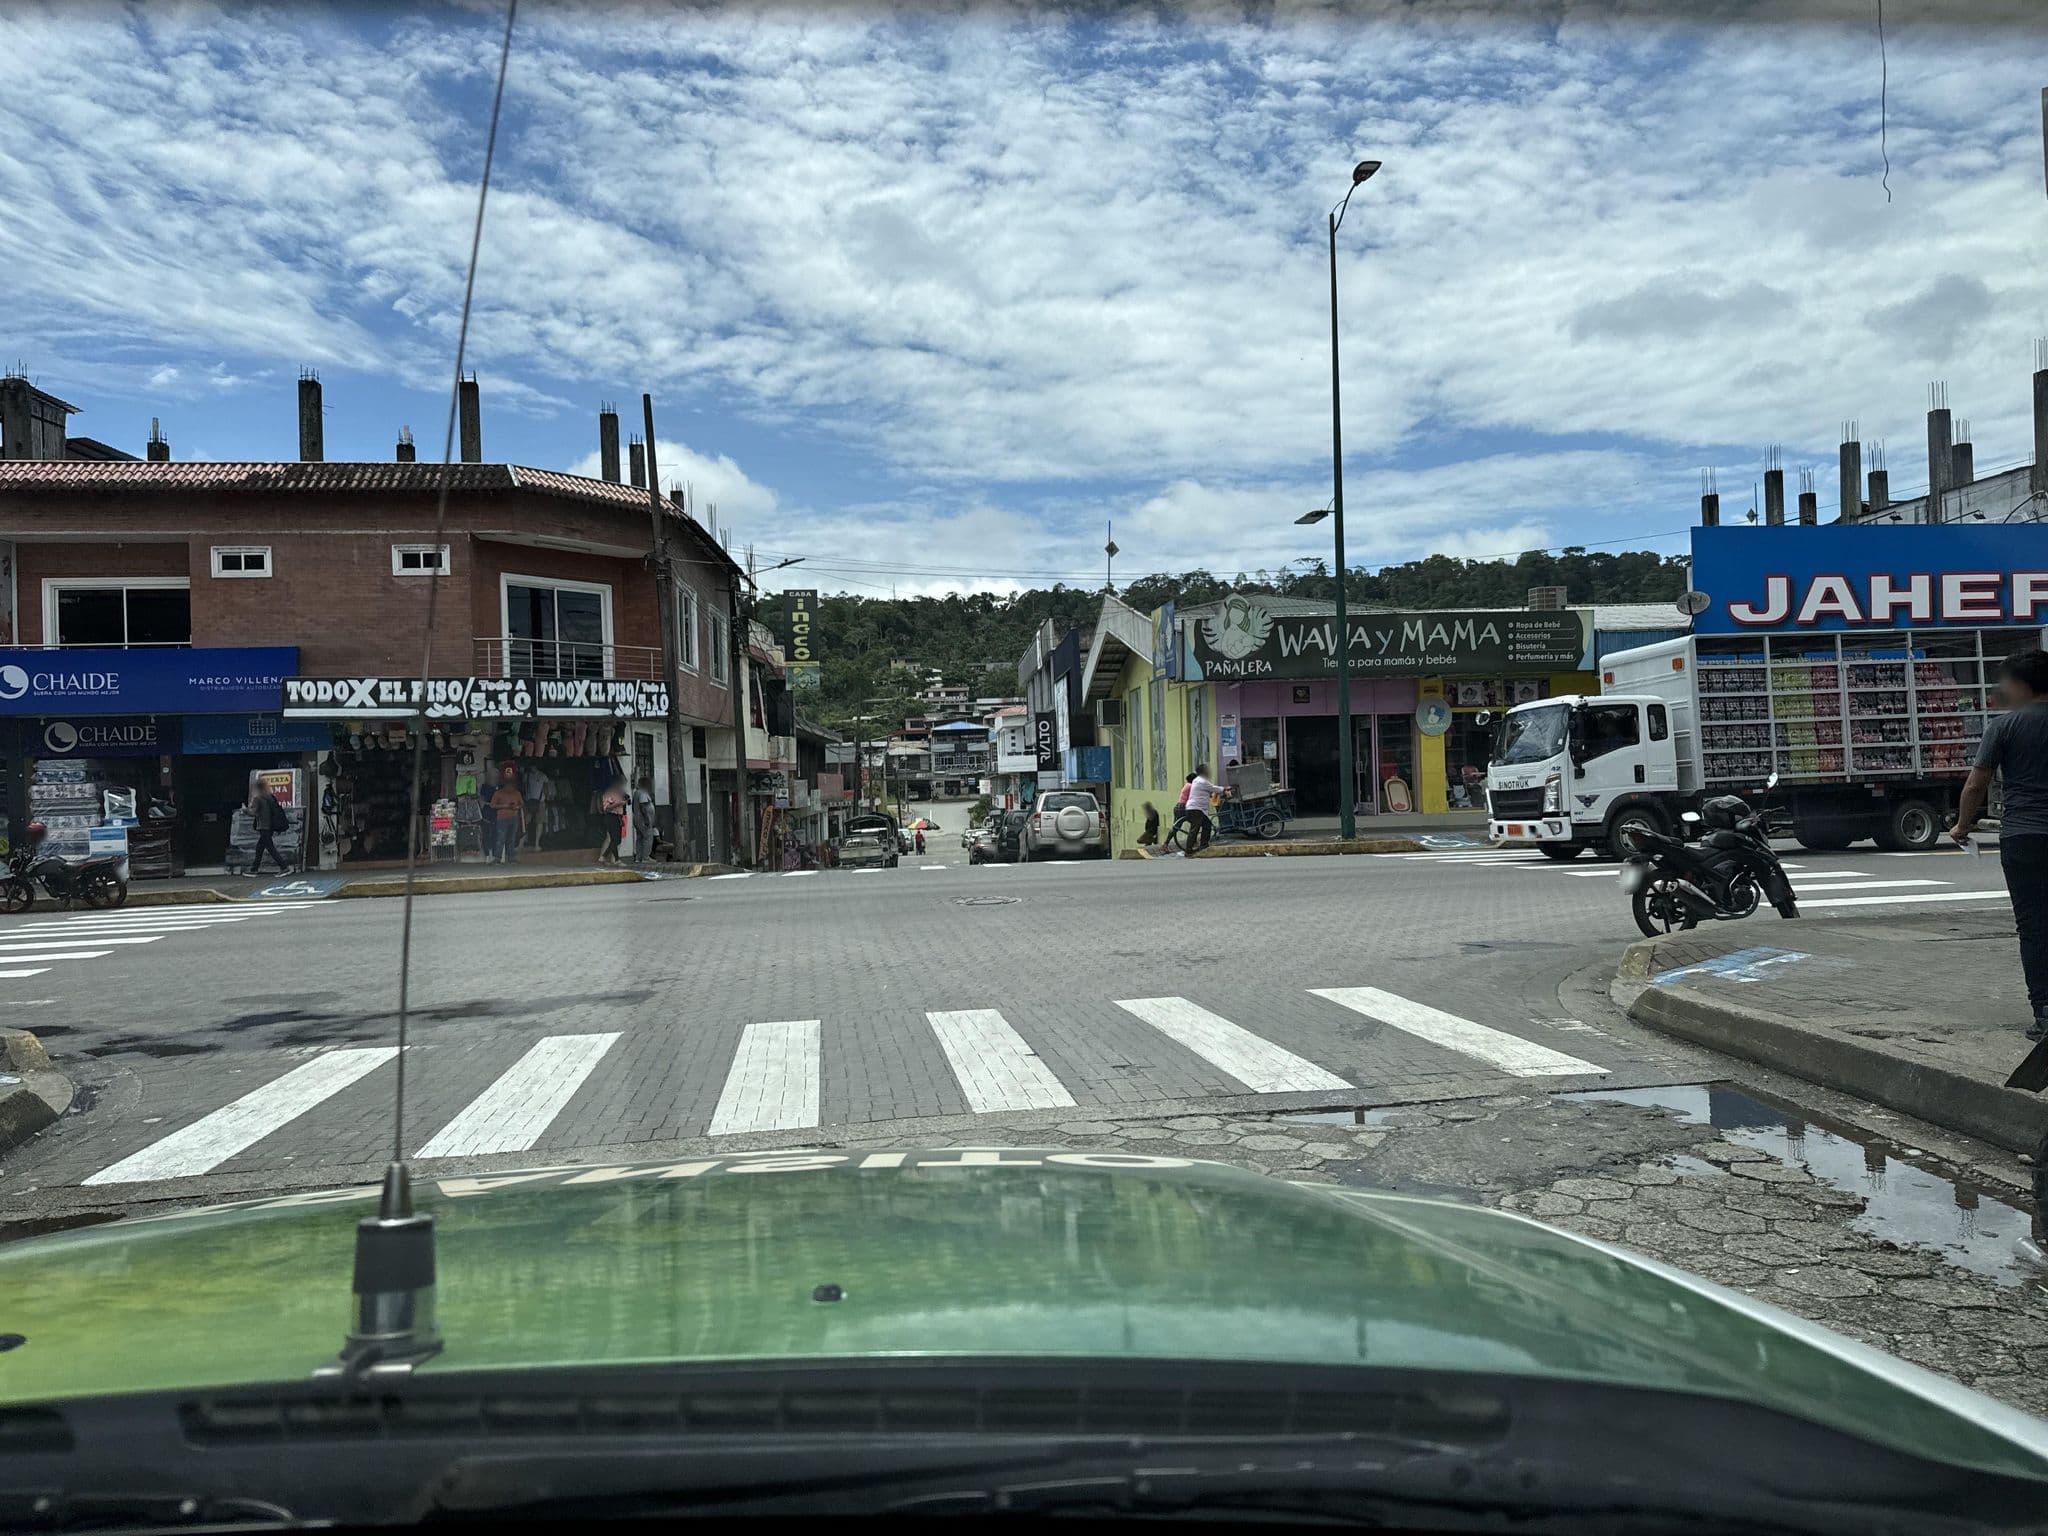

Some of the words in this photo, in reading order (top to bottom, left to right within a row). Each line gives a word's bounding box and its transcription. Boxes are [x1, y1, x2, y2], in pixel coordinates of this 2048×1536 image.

[1400, 618, 1501, 652] MAMA
[1516, 642, 1546, 650] Bisutería
[1357, 657, 1382, 668] para
[1384, 654, 1416, 666] mamás
[1417, 656, 1425, 666] y
[1426, 653, 1457, 665] bebés
[1516, 652, 1553, 660] Perfumería
[1560, 651, 1574, 660] más
[1205, 659, 1273, 677] PAÑALERA
[33, 673, 120, 691] CHAIDE
[189, 677, 231, 685] MARCO
[286, 680, 349, 703] TODO
[379, 681, 407, 703] EL
[411, 680, 464, 703] PISO
[541, 681, 575, 703] TODO
[591, 683, 606, 703] EL
[608, 682, 634, 703] PISO
[79, 726, 157, 742] CHAIDE
[1498, 780, 1529, 790] SINOTRUK
